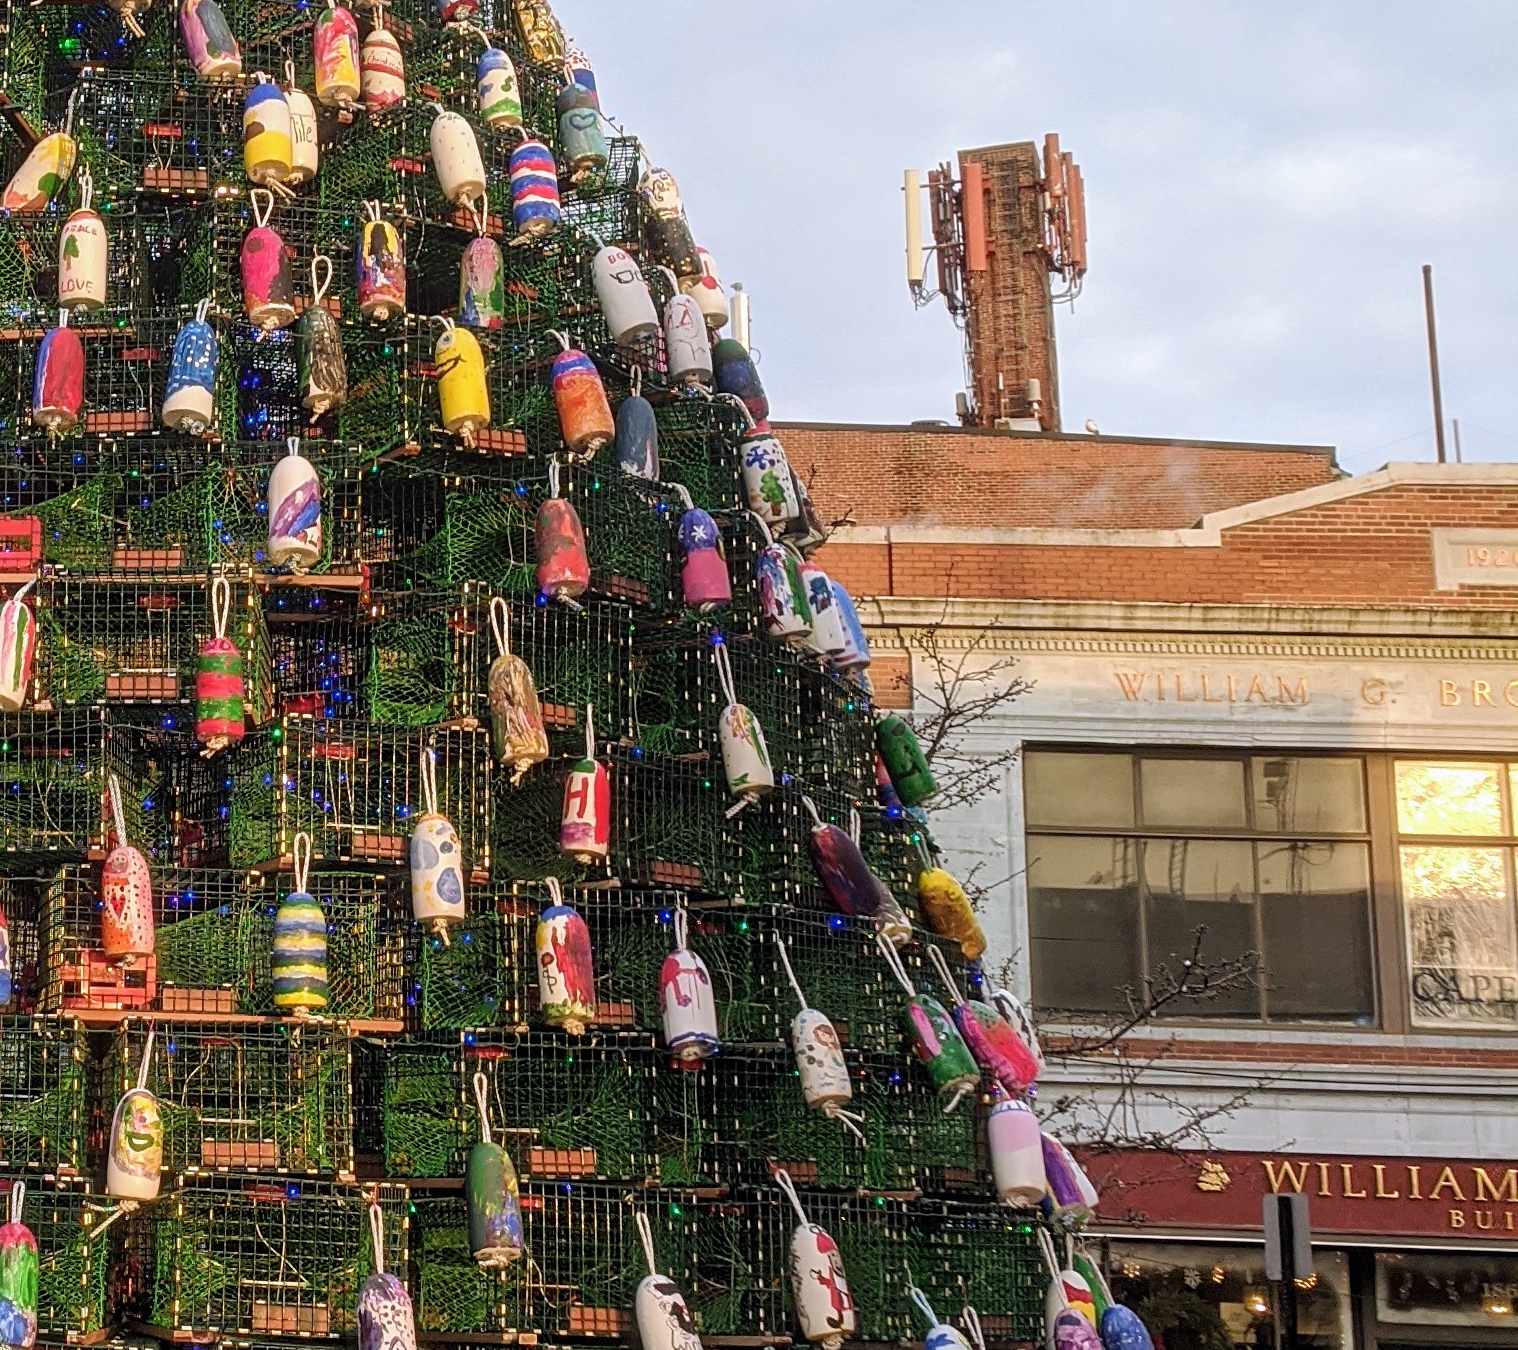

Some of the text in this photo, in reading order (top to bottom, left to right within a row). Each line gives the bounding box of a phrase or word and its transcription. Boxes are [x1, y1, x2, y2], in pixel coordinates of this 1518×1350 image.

[60, 279, 94, 294] LOVE
[1467, 546, 1518, 567] 192
[1114, 671, 1311, 704] WILLIAM
[1261, 1160, 1518, 1203] WILLIAM
[1449, 1209, 1518, 1230] BUI
